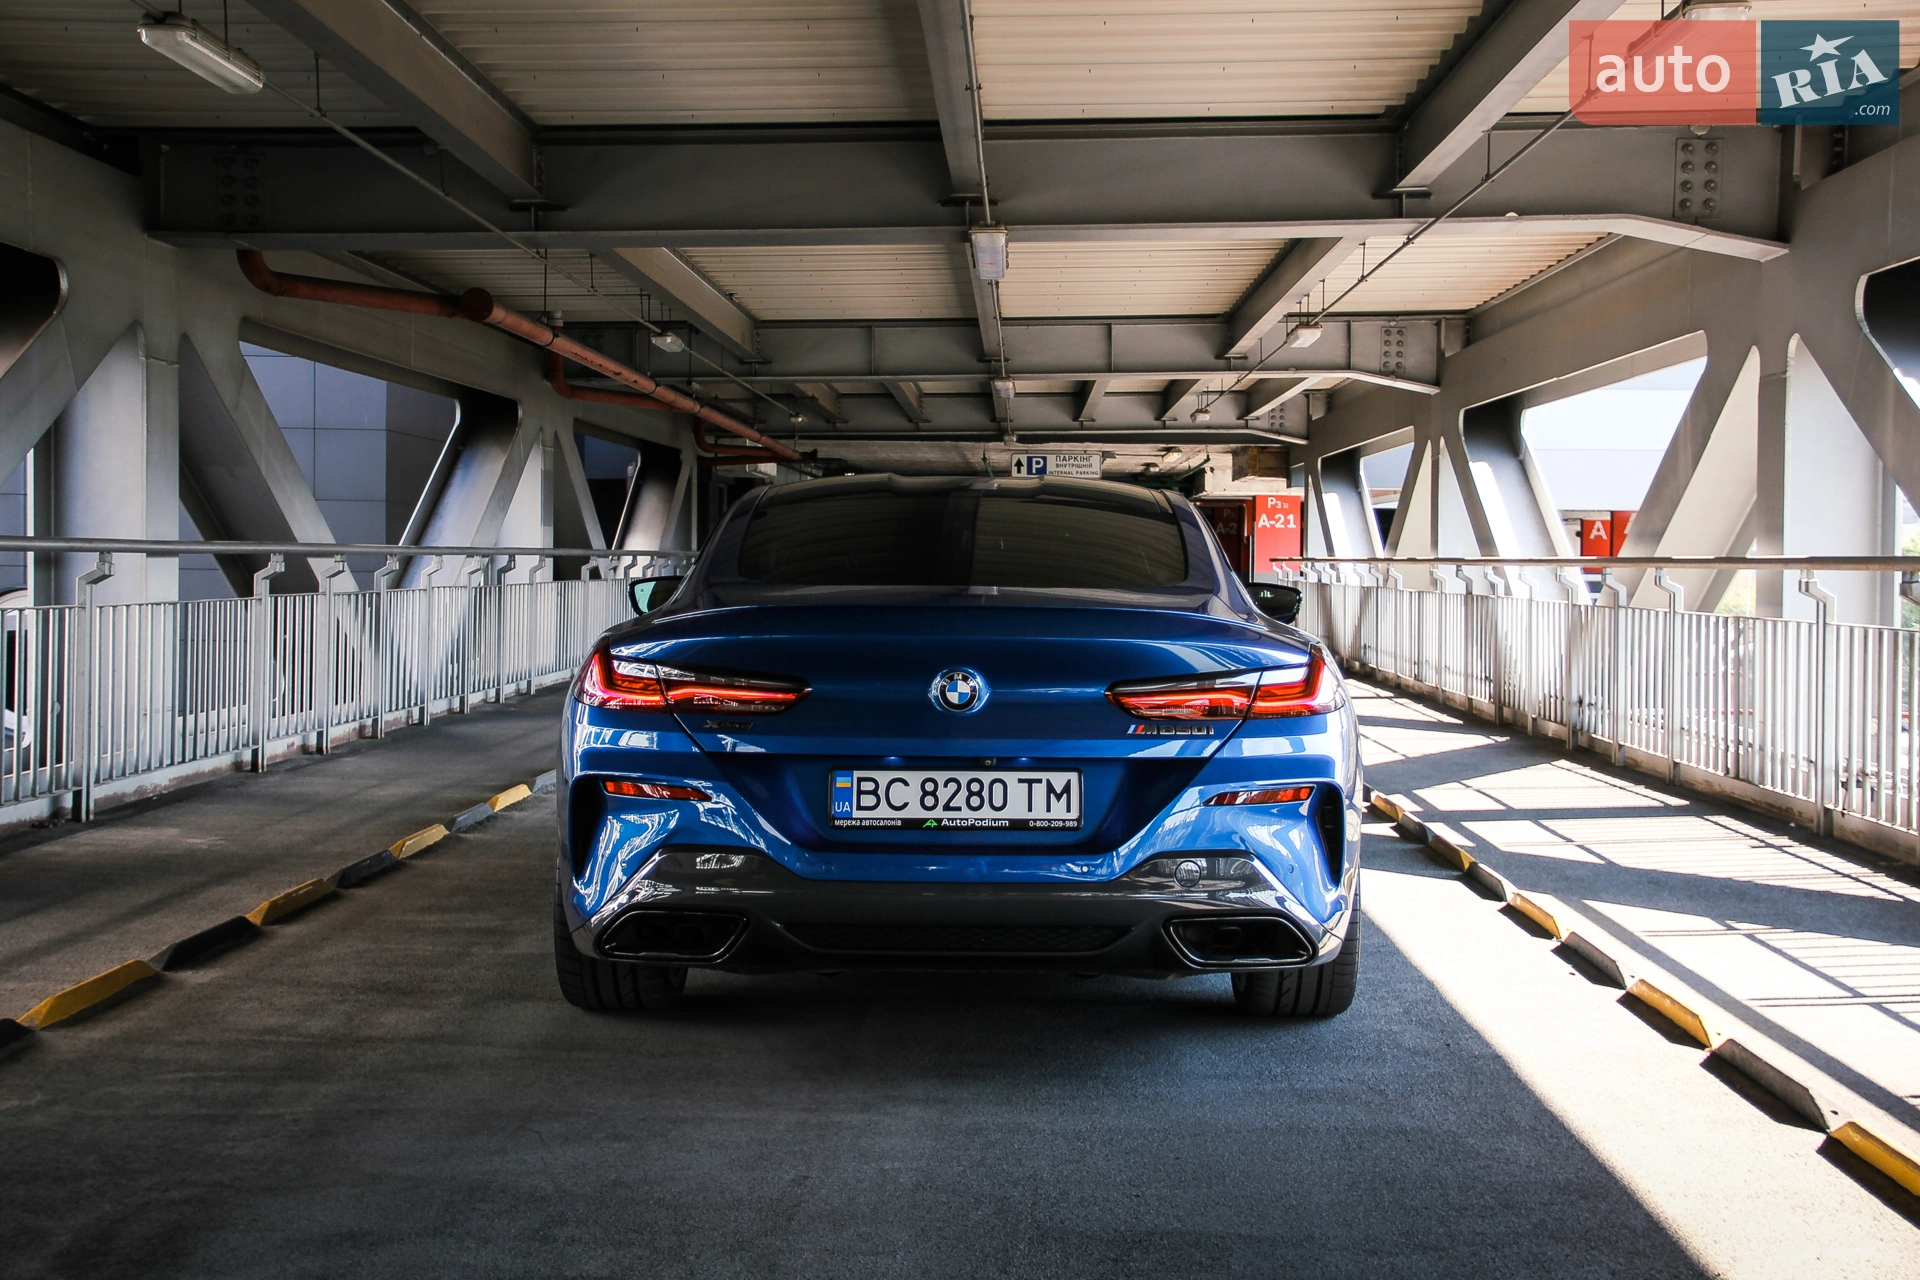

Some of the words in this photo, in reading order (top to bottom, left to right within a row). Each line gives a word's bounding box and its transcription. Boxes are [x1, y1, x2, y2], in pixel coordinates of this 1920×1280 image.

[1055, 455, 1093, 463] ПАРКІНГ
[1032, 457, 1044, 474] P
[1257, 513, 1297, 528] A-21
[1589, 520, 1608, 540] A
[855, 776, 911, 812] BC
[919, 776, 1009, 812] 8280
[1017, 777, 1072, 814] TM
[834, 801, 851, 813] UA
[834, 819, 860, 828] мережа
[861, 818, 902, 827] автосалонів
[941, 818, 1009, 827] AutoPodium
[1028, 820, 1078, 828] 0-800-209-989
